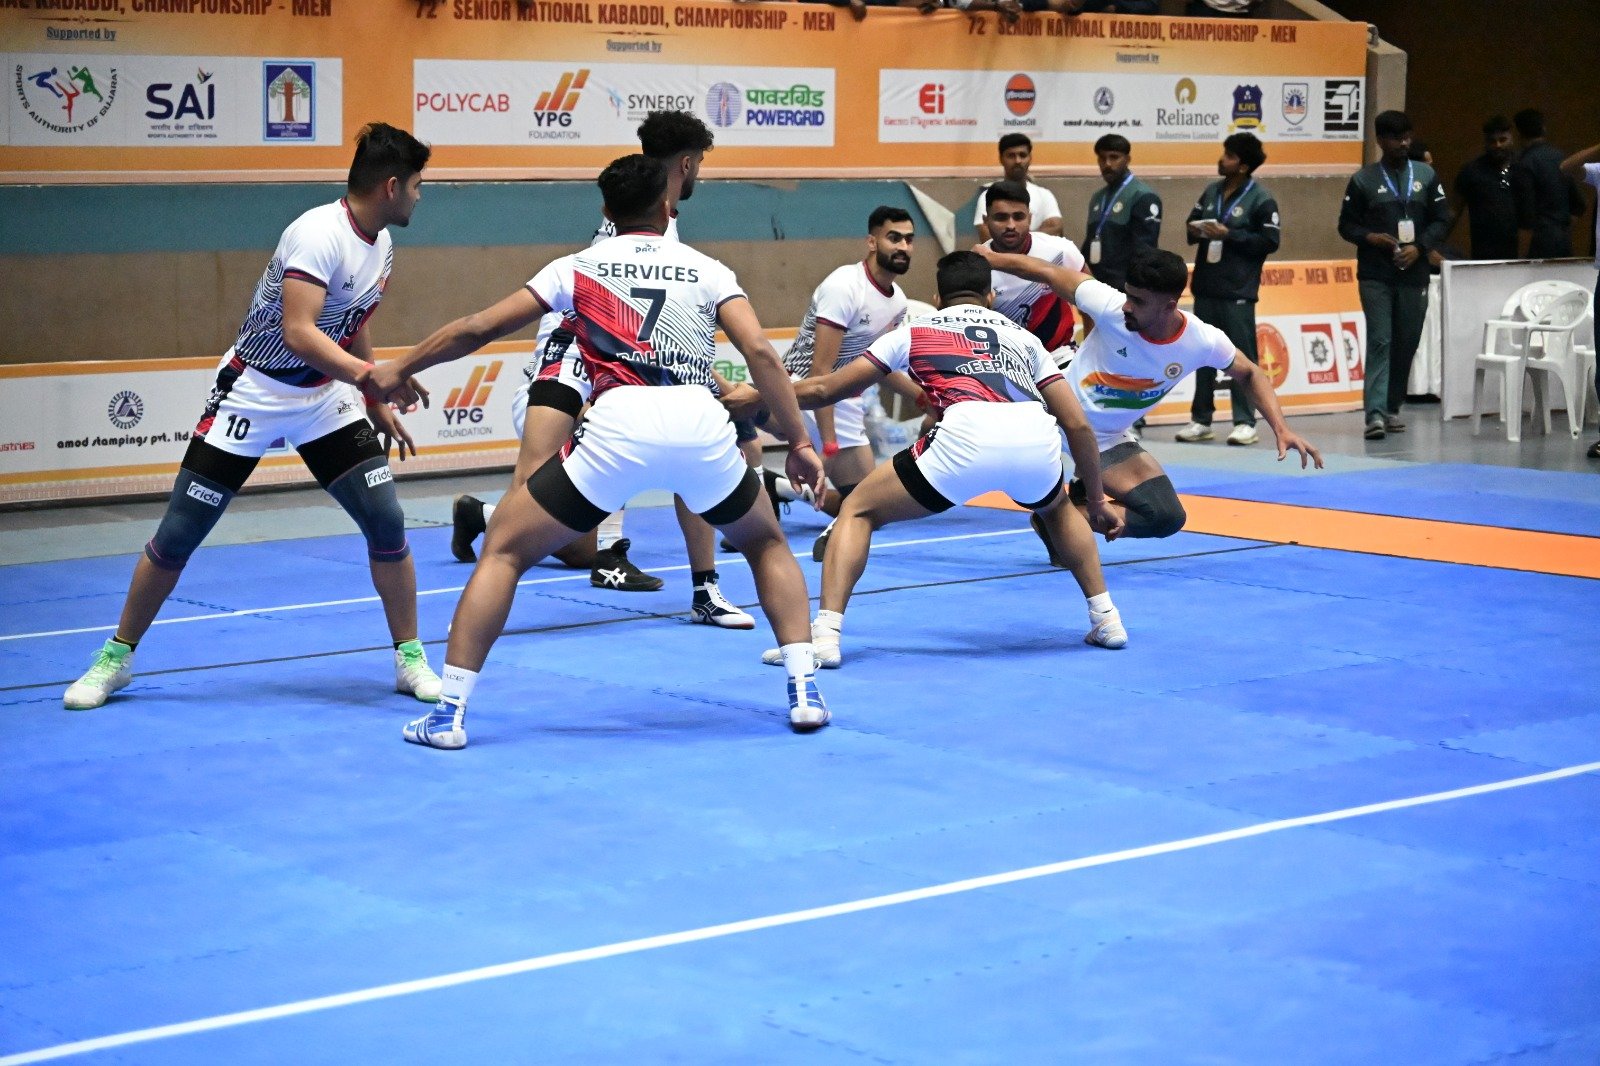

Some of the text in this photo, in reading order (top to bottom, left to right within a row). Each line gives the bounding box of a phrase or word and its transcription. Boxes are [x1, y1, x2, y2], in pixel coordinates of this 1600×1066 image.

[292, 0, 331, 16] MEN
[454, 0, 511, 20] SENIOR
[517, 2, 593, 24] NATIONAL
[598, 4, 669, 28] KABADDI,
[675, 6, 787, 29] CHAMPIONSHIP
[803, 11, 835, 31] MEN
[46, 26, 117, 42] Supported by
[1047, 18, 1104, 38] NATIONAL
[1110, 20, 1165, 42] KABADDI,
[1169, 22, 1259, 42] CHAMPIONSHIP
[1271, 25, 1297, 43] MEN
[606, 38, 662, 52] Supported by
[16, 64, 118, 133] SPORTS AUTHORITY OF GUJARAT
[145, 83, 215, 120] SAI
[416, 93, 510, 113] POLYCAB
[628, 94, 695, 110] SYNERGY
[533, 111, 573, 127] YPG
[746, 109, 825, 127] POWERGRID
[1003, 118, 1036, 127] IndianOil
[1156, 107, 1220, 126] Reliance
[528, 130, 581, 139] FOUNDATION
[597, 262, 699, 283] SERVICES
[1305, 267, 1328, 285] MEN
[630, 287, 667, 342] 7
[963, 325, 1001, 360] 9
[443, 407, 484, 425] YPG
[228, 414, 250, 440] 10
[437, 426, 493, 439] FOUNDATION
[57, 431, 192, 448] amod stampings pvt. ltd.
[188, 483, 223, 506] Frido
